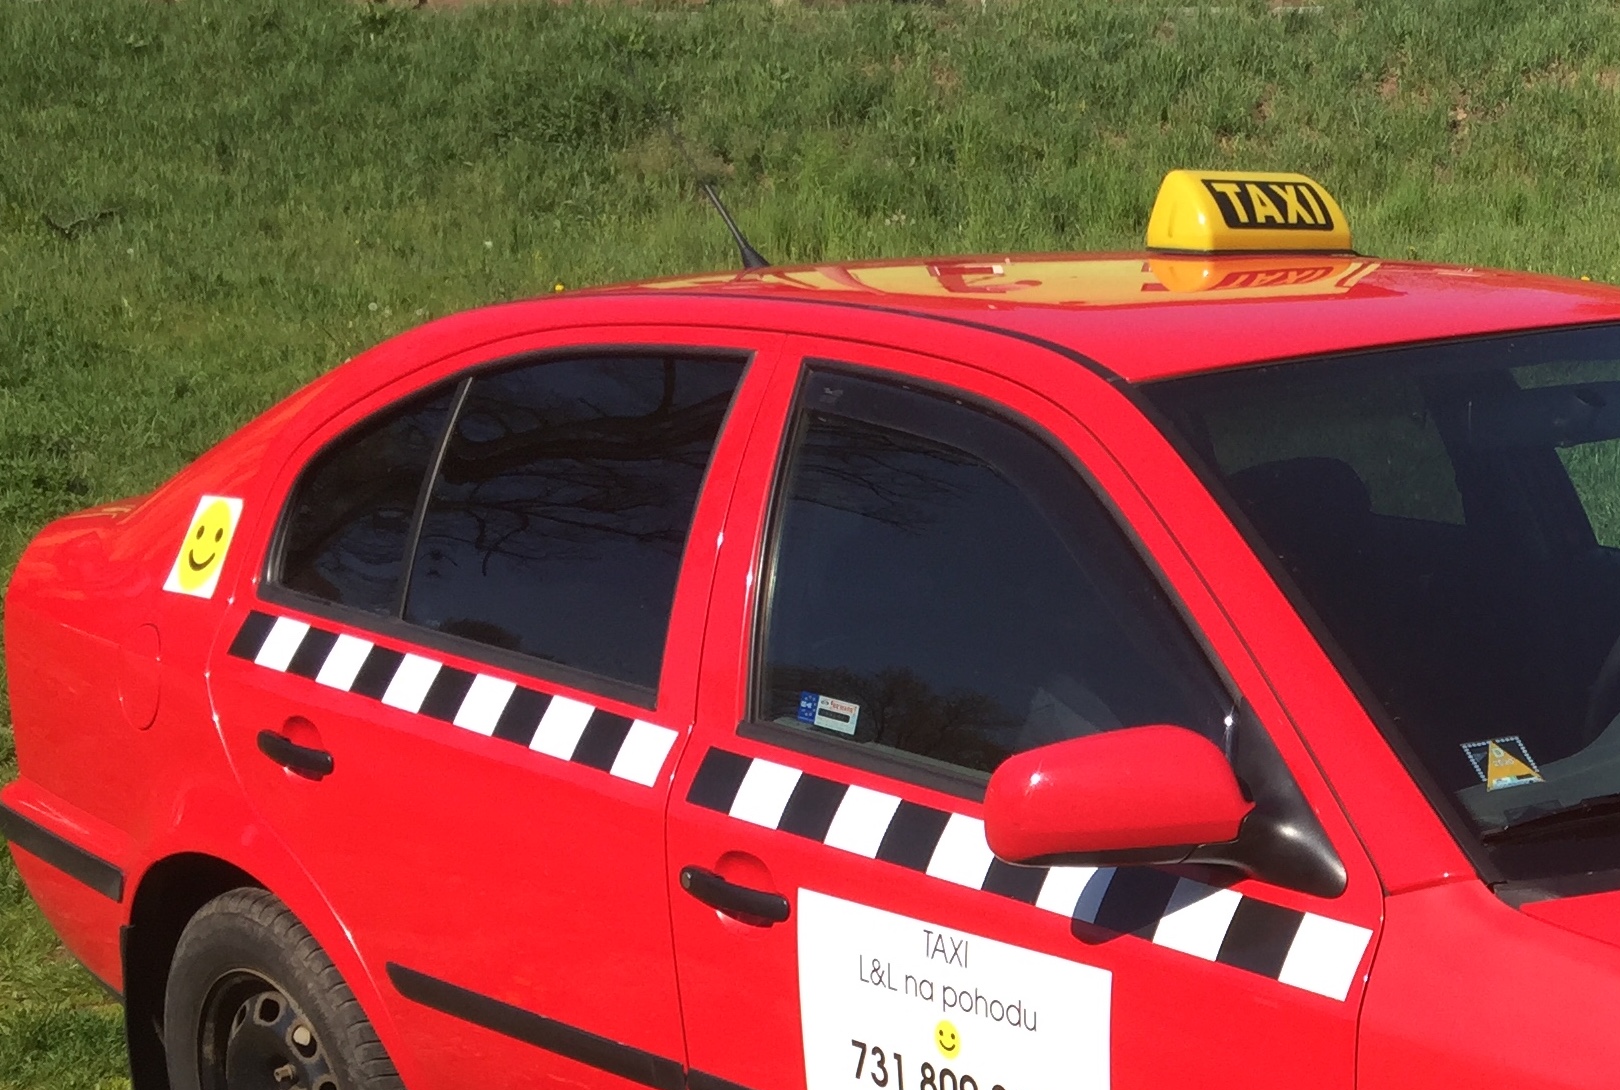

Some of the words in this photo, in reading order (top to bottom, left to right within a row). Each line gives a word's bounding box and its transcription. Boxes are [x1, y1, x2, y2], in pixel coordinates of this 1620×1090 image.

[1211, 182, 1327, 225] TAXI
[923, 929, 968, 968] TAXI
[859, 955, 897, 991] L&L
[905, 974, 934, 1002] na
[942, 985, 1037, 1032] pohodu
